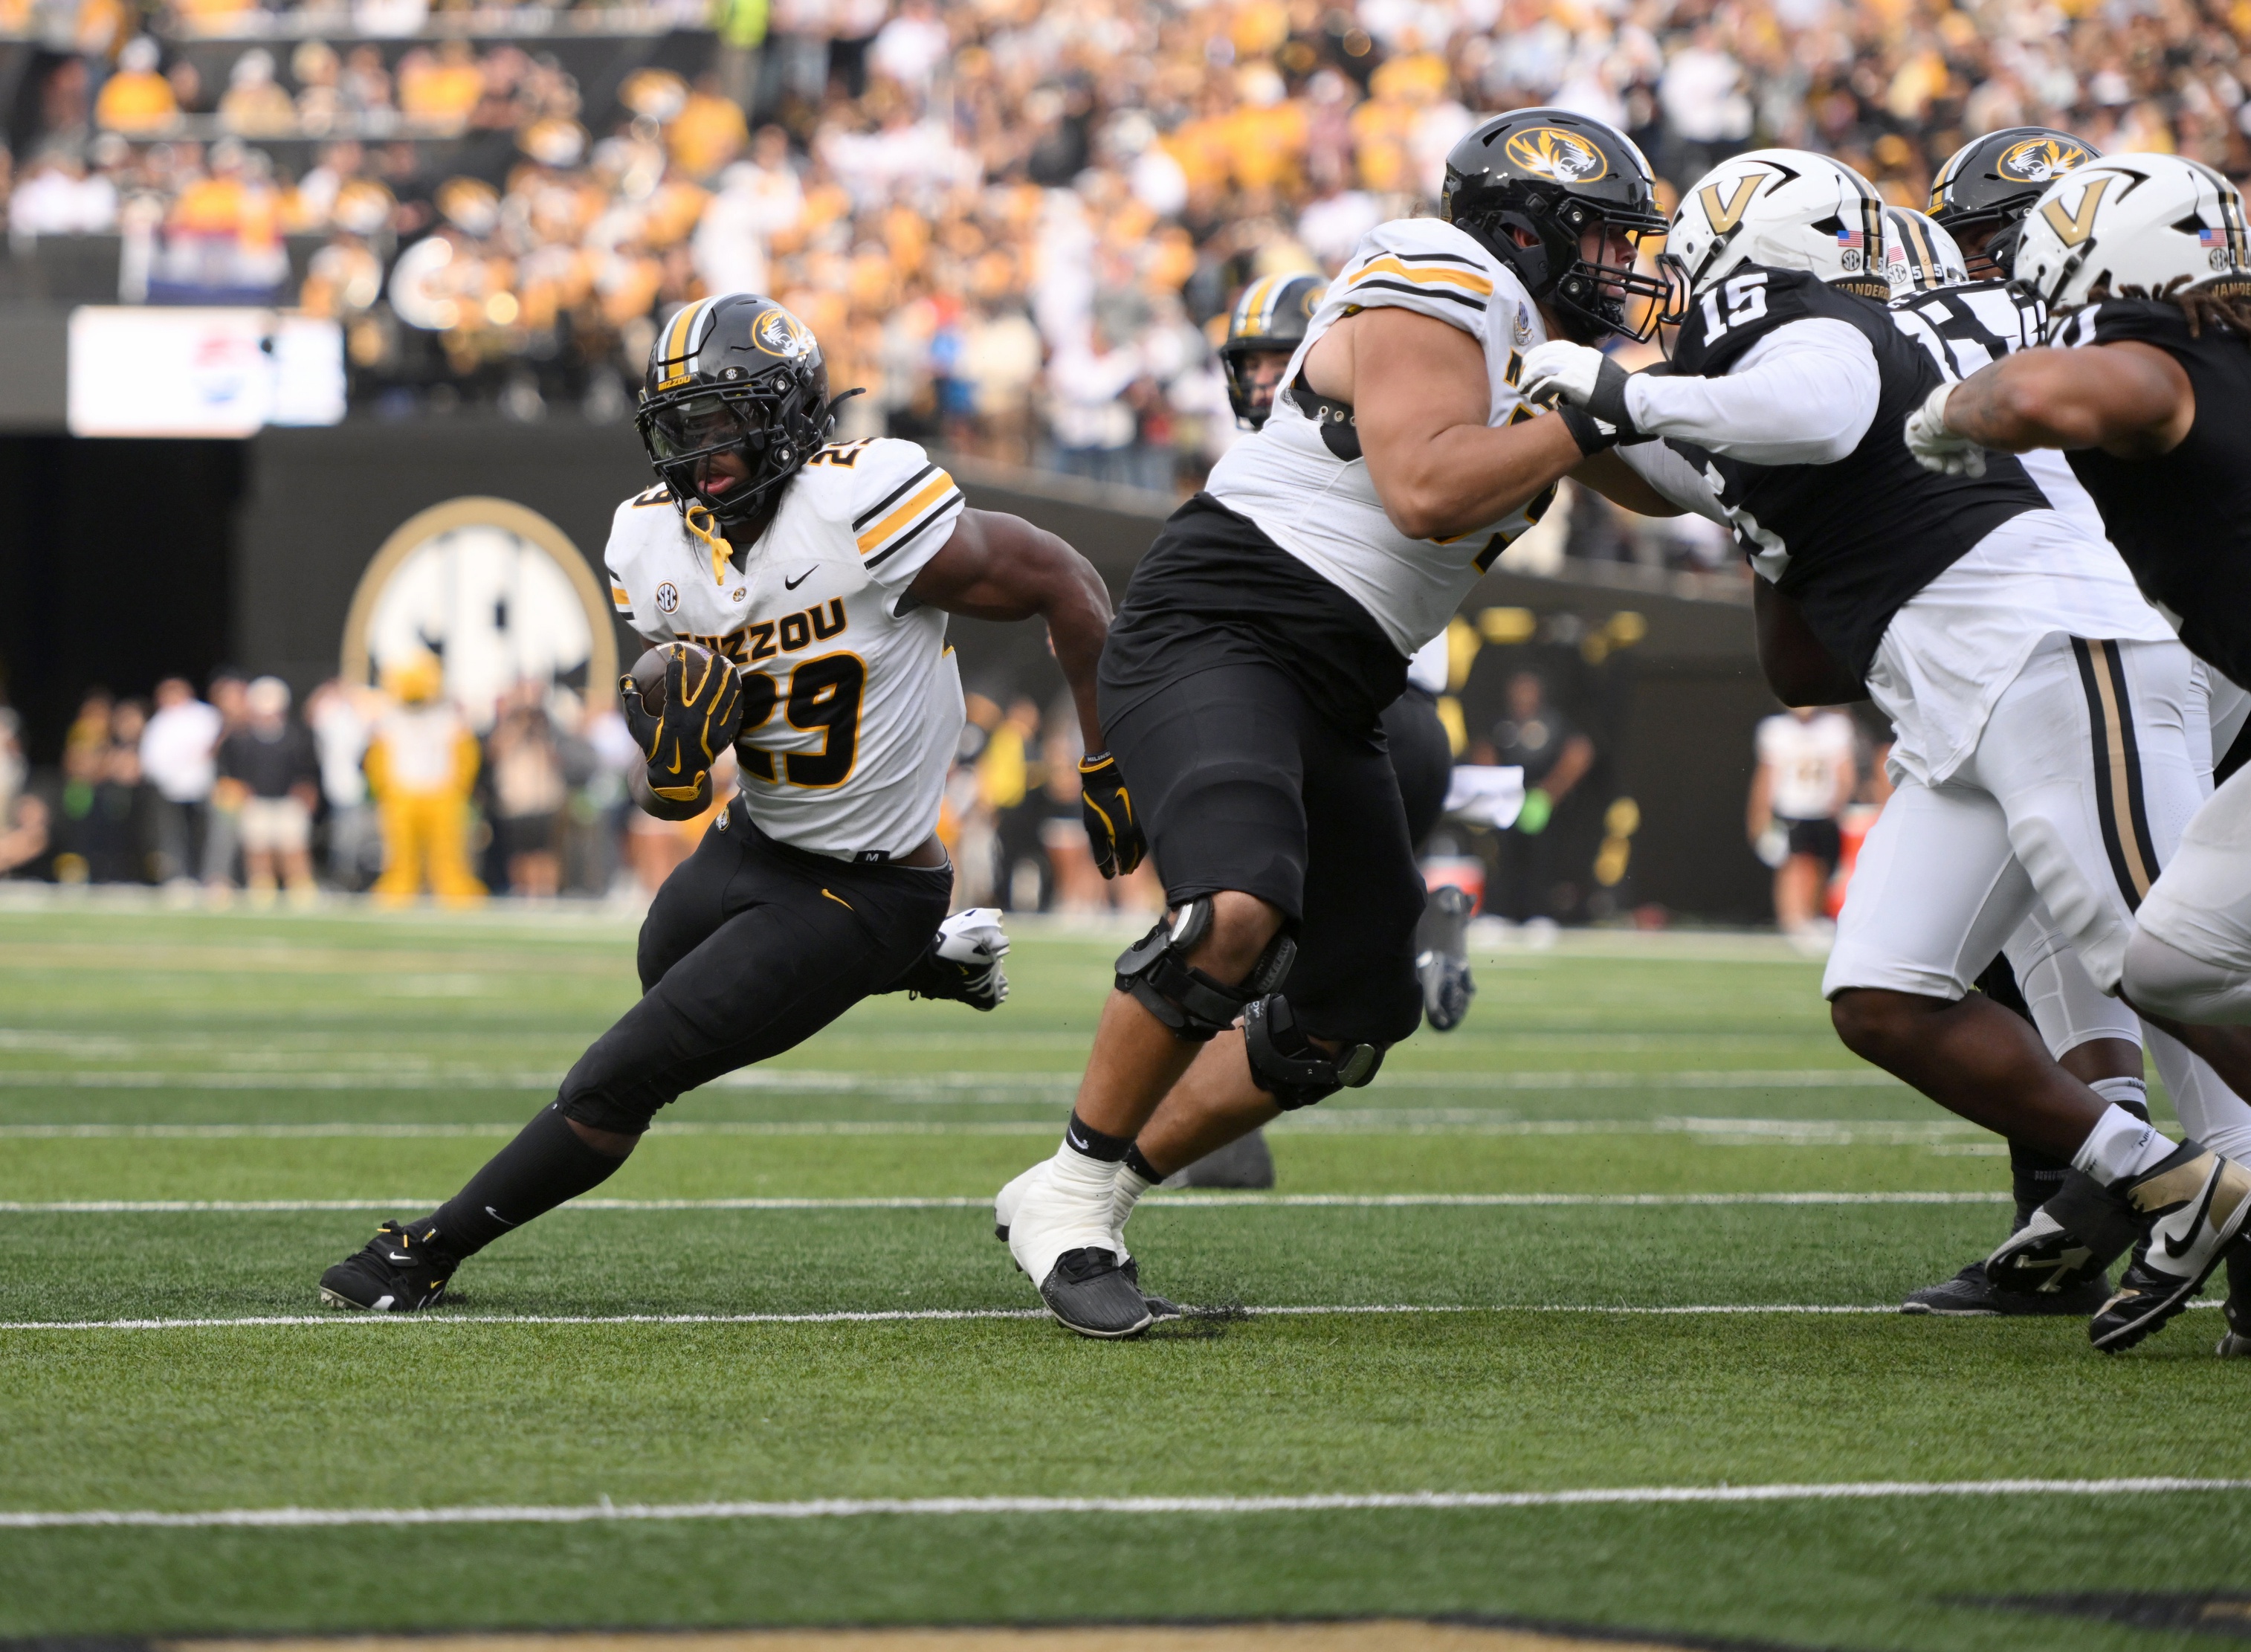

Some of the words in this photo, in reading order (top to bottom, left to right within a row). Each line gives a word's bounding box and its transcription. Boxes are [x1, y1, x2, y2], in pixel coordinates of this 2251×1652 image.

[1842, 250, 1860, 271] SEC
[1699, 272, 1769, 348] 15
[659, 375, 692, 391] MIZZOU
[726, 369, 738, 381] SEC
[657, 584, 678, 610] SEC
[734, 649, 868, 790] 29
[865, 853, 879, 862] M
